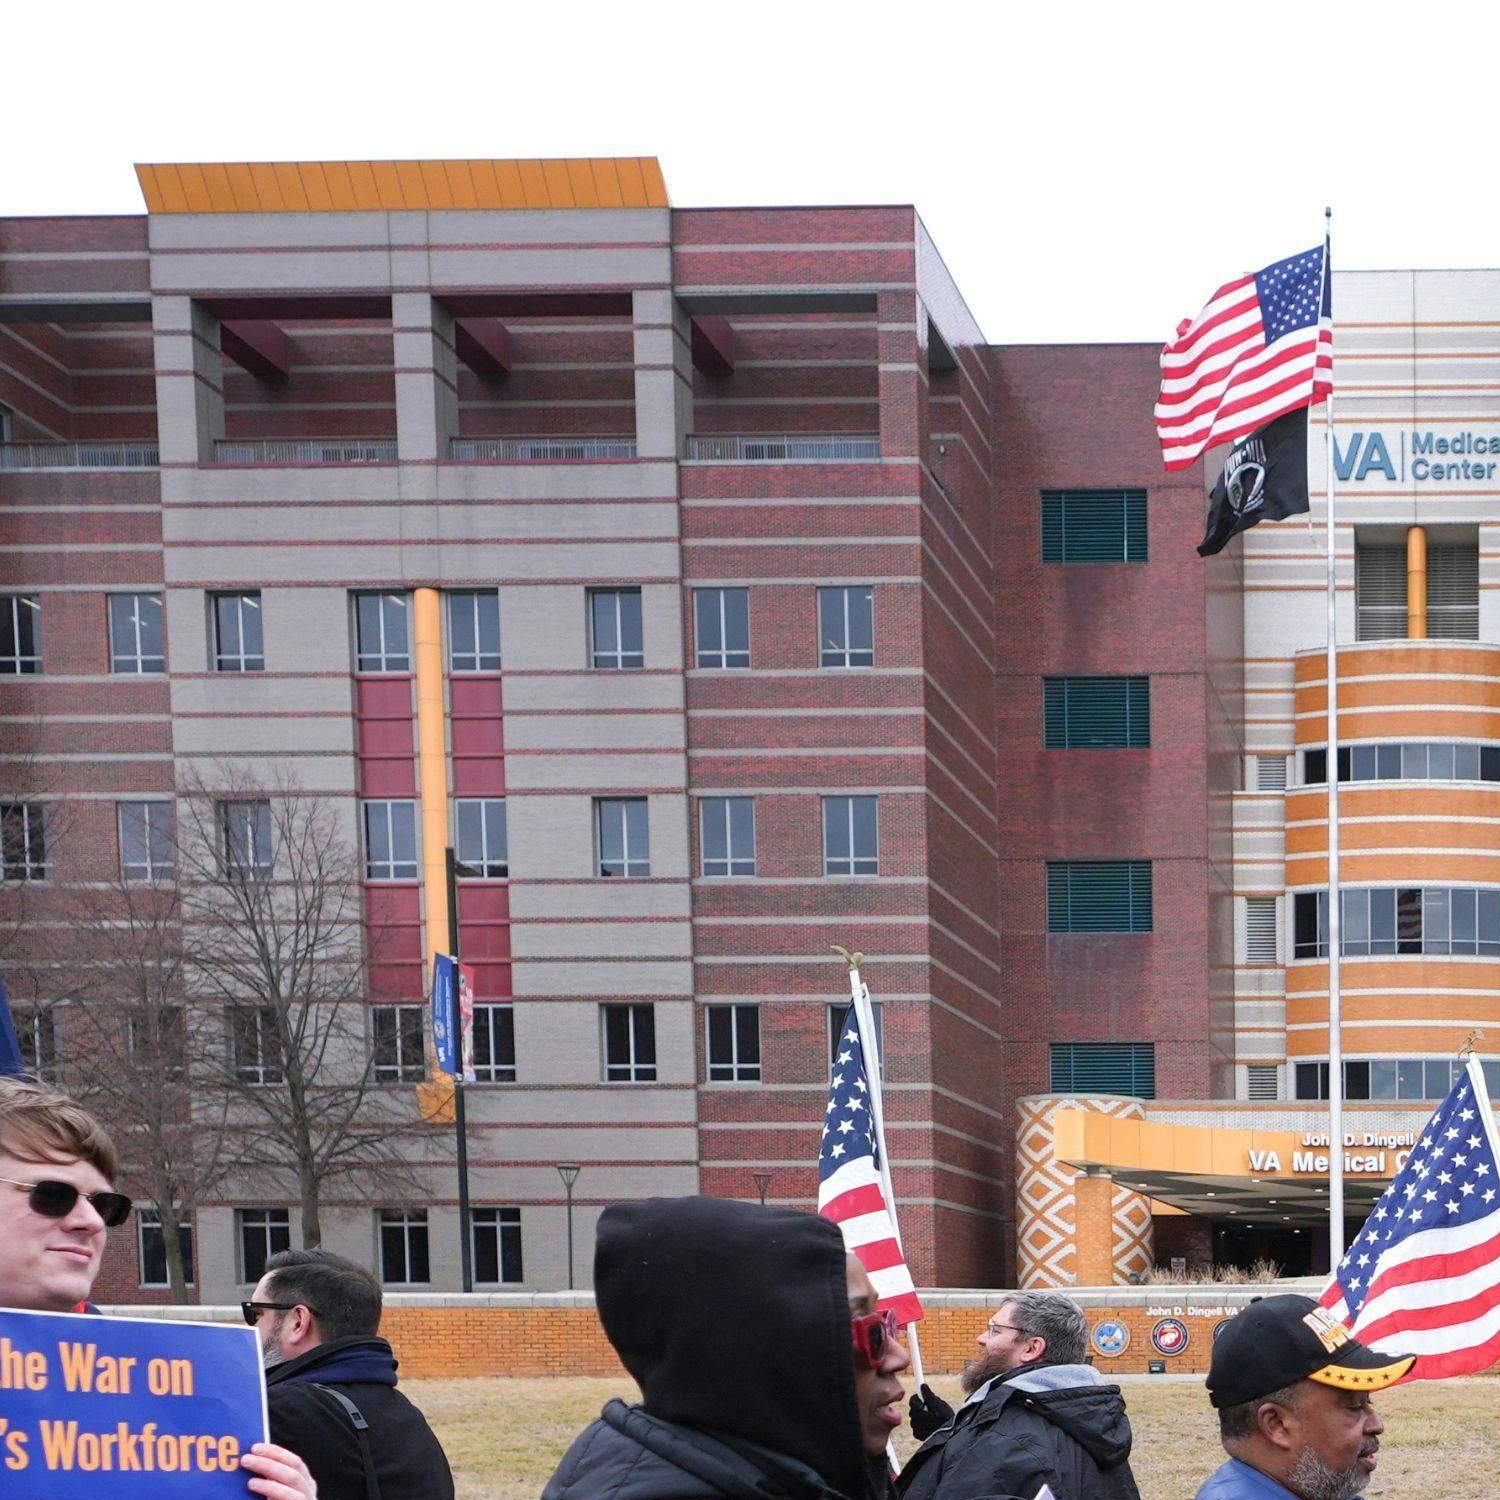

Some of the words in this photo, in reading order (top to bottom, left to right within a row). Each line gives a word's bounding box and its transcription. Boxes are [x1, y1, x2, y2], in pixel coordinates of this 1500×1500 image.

[1325, 432, 1396, 480] VA
[1412, 458, 1495, 480] Center
[1302, 1134, 1331, 1147] Joh
[1343, 1134, 1358, 1147] D.
[1363, 1134, 1414, 1150] Dingell
[1248, 1150, 1281, 1171] VA
[1292, 1150, 1385, 1172] Meical
[1146, 1306, 1169, 1317] John
[1171, 1306, 1185, 1316] D.
[1188, 1306, 1223, 1319] Dingell
[1223, 1306, 1239, 1316] VA
[0, 1337, 47, 1390] he
[58, 1342, 136, 1395] War
[148, 1357, 194, 1397] on
[39, 1419, 241, 1472] Workforce
